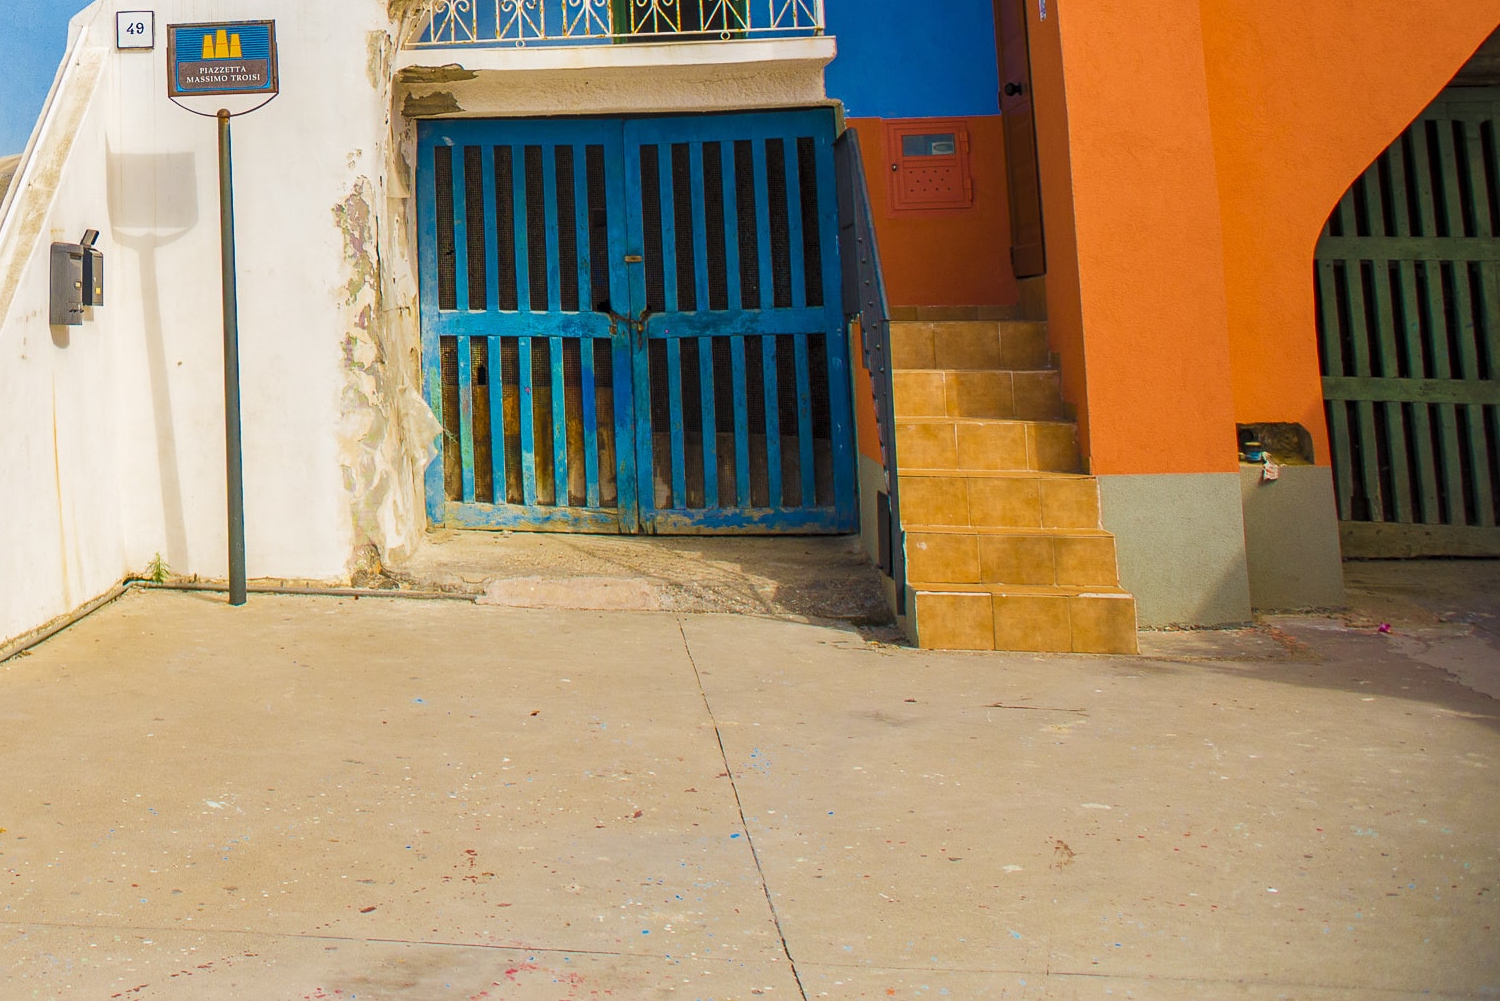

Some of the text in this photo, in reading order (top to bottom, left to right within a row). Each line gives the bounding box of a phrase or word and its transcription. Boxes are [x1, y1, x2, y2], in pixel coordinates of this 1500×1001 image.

[126, 22, 145, 35] 49
[199, 66, 247, 74] PIAZZETTA
[186, 74, 260, 84] MASSIMO TROISI
